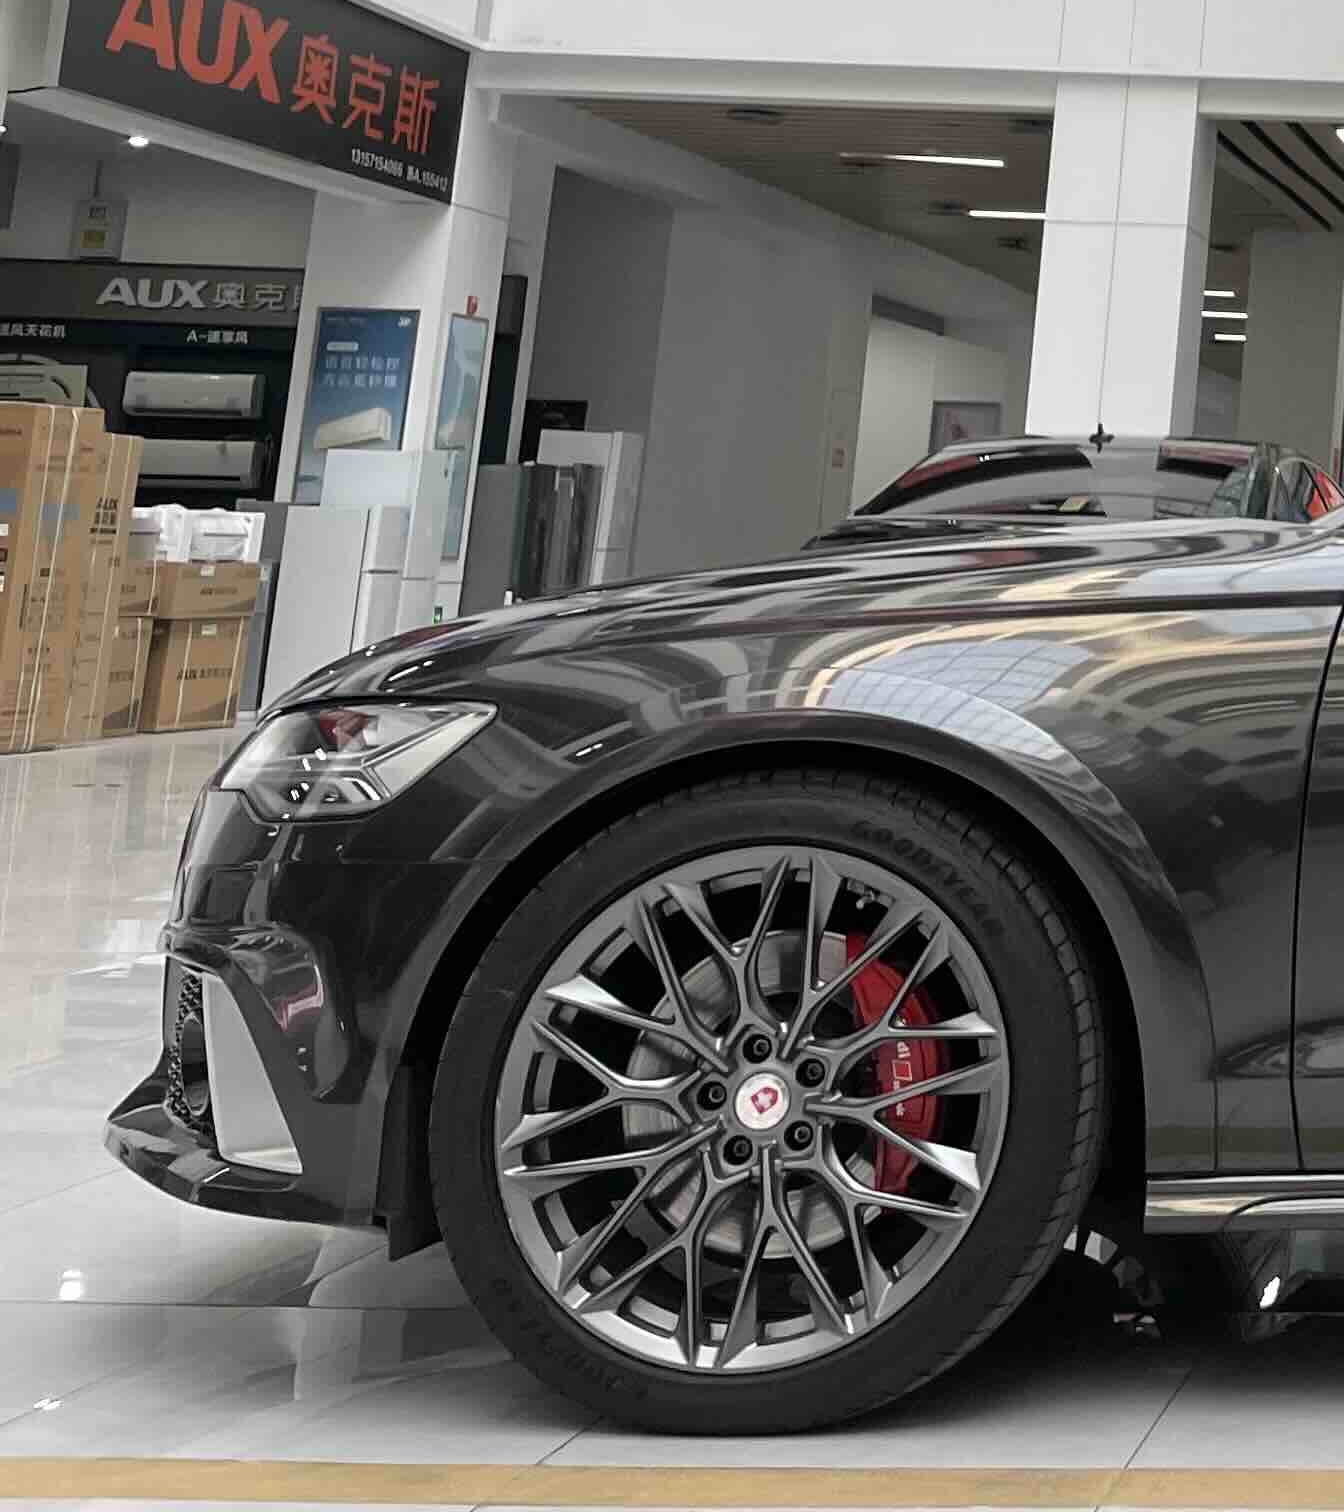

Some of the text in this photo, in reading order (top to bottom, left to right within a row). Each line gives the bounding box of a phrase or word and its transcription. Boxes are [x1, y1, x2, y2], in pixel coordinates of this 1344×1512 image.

[290, 33, 441, 155] 奥克斯
[95, 277, 209, 309] AUX
[212, 281, 301, 311] 奥克
